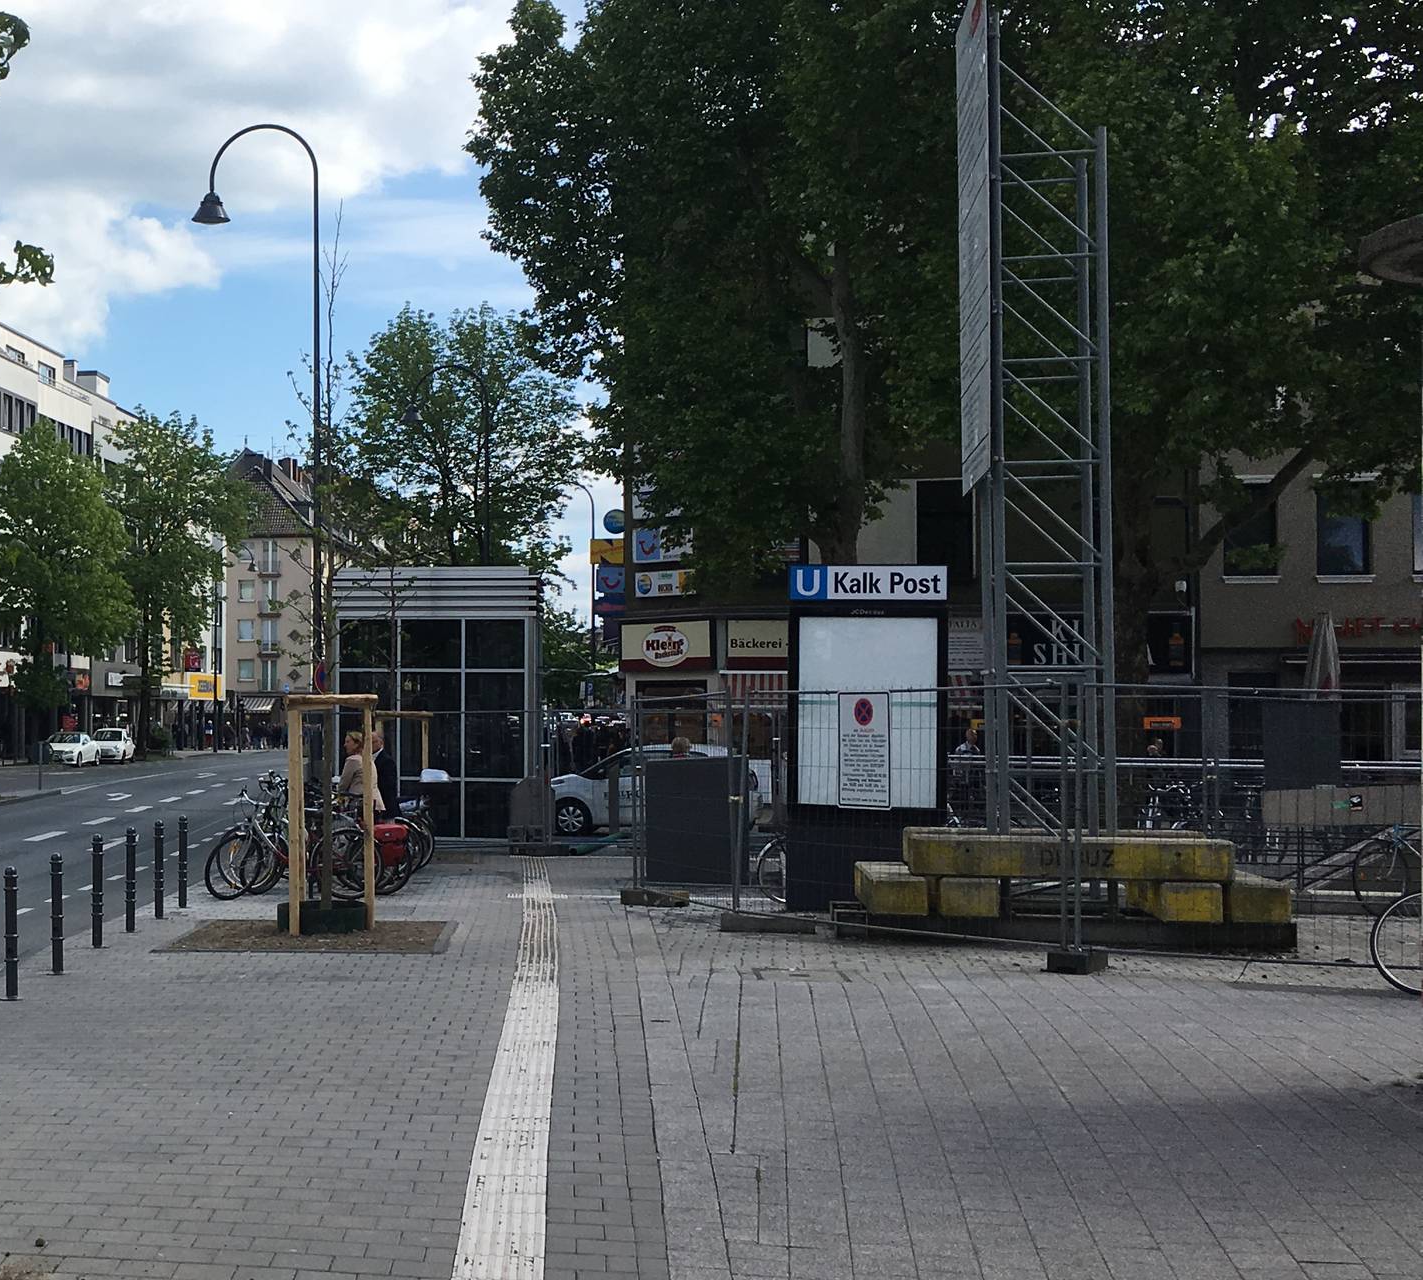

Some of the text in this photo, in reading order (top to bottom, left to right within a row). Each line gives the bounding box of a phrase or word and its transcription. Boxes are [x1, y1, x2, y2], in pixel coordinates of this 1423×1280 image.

[796, 569, 941, 596] U Kalk Post
[730, 638, 782, 649] Bäckerei
